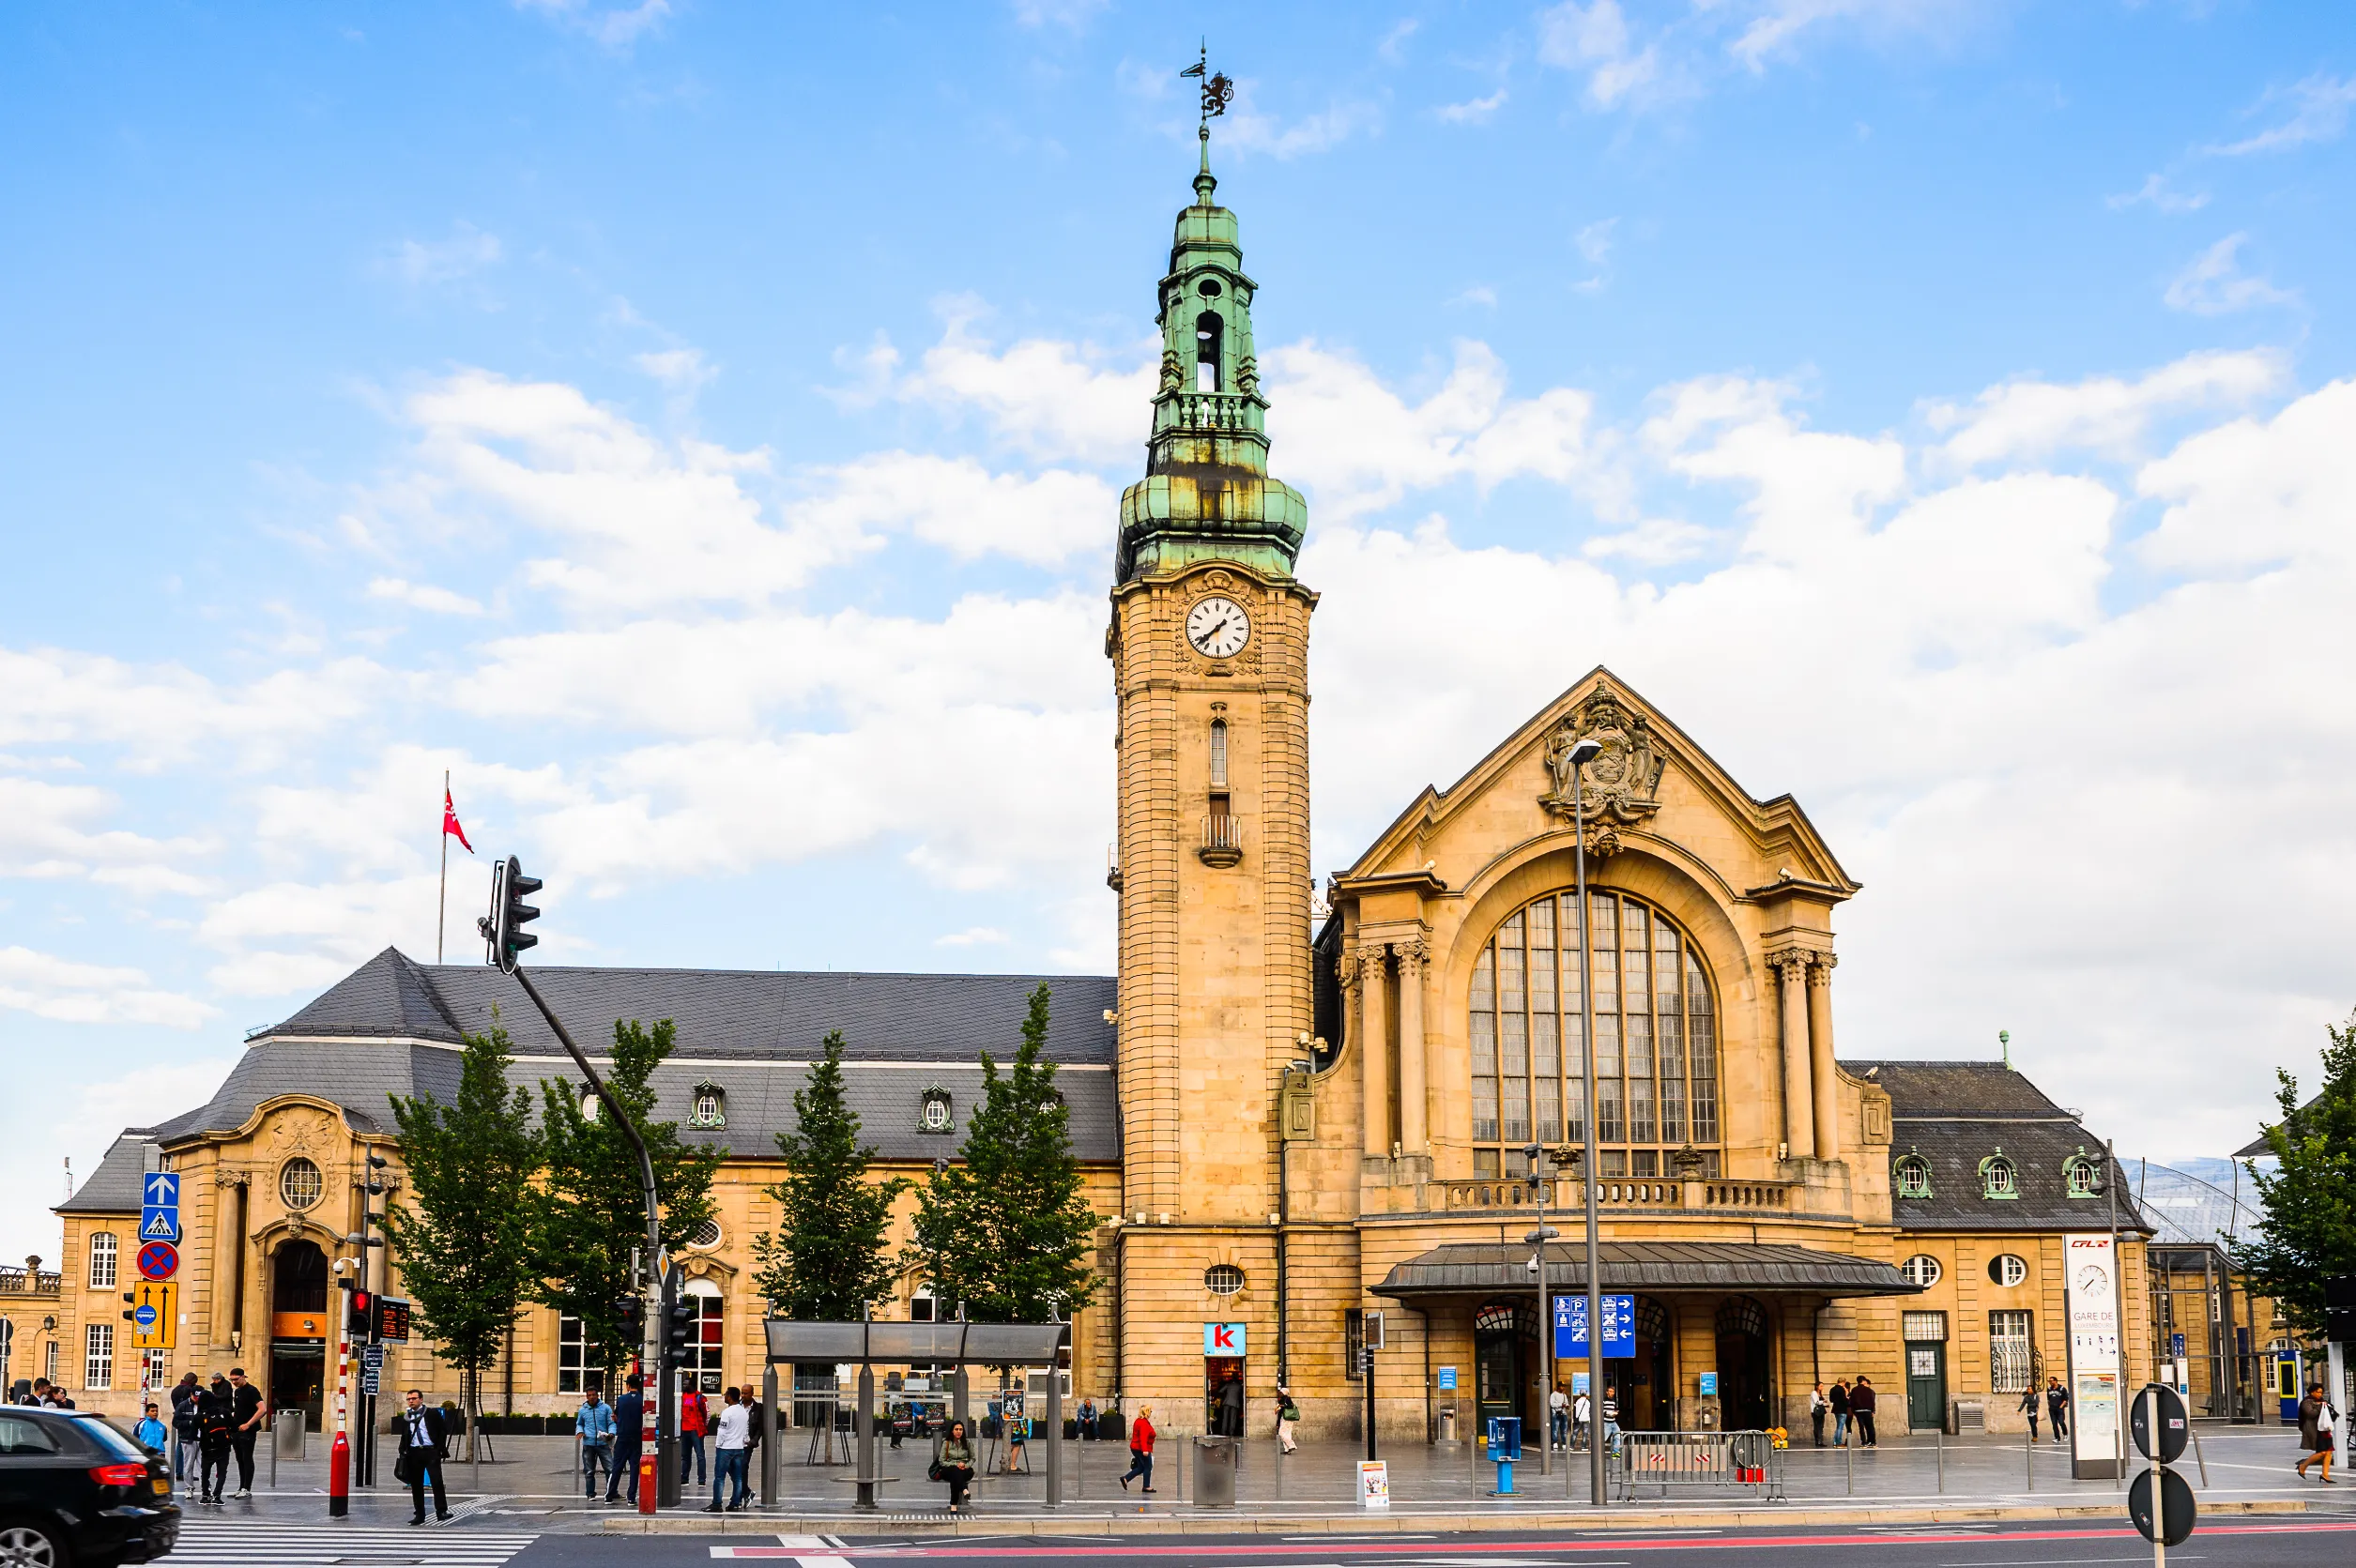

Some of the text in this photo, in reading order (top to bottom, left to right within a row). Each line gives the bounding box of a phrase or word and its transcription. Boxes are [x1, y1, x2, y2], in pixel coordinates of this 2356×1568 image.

[1574, 1302, 1583, 1312] P
[2073, 1312, 2114, 1321] GARE DE
